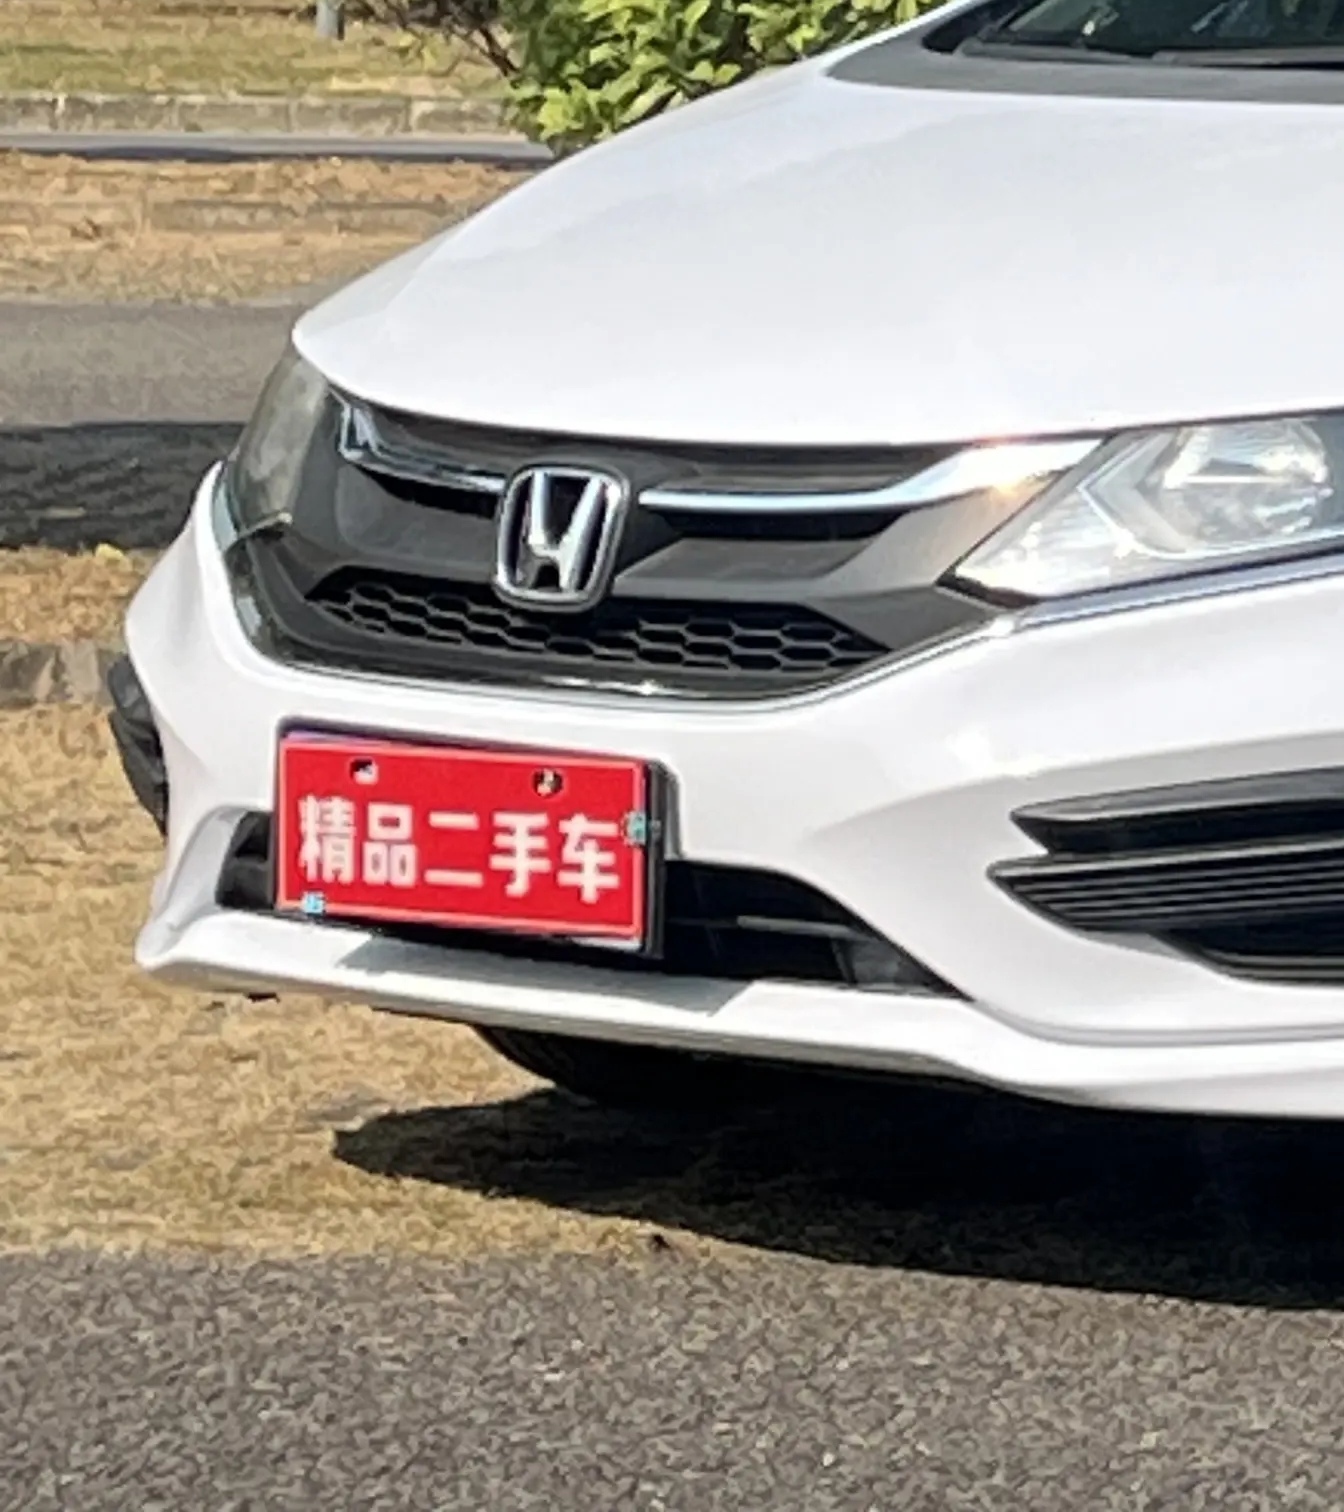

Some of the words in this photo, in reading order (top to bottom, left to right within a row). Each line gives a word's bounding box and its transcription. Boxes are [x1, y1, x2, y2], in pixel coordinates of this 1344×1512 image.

[297, 794, 621, 903] 精品二手车
